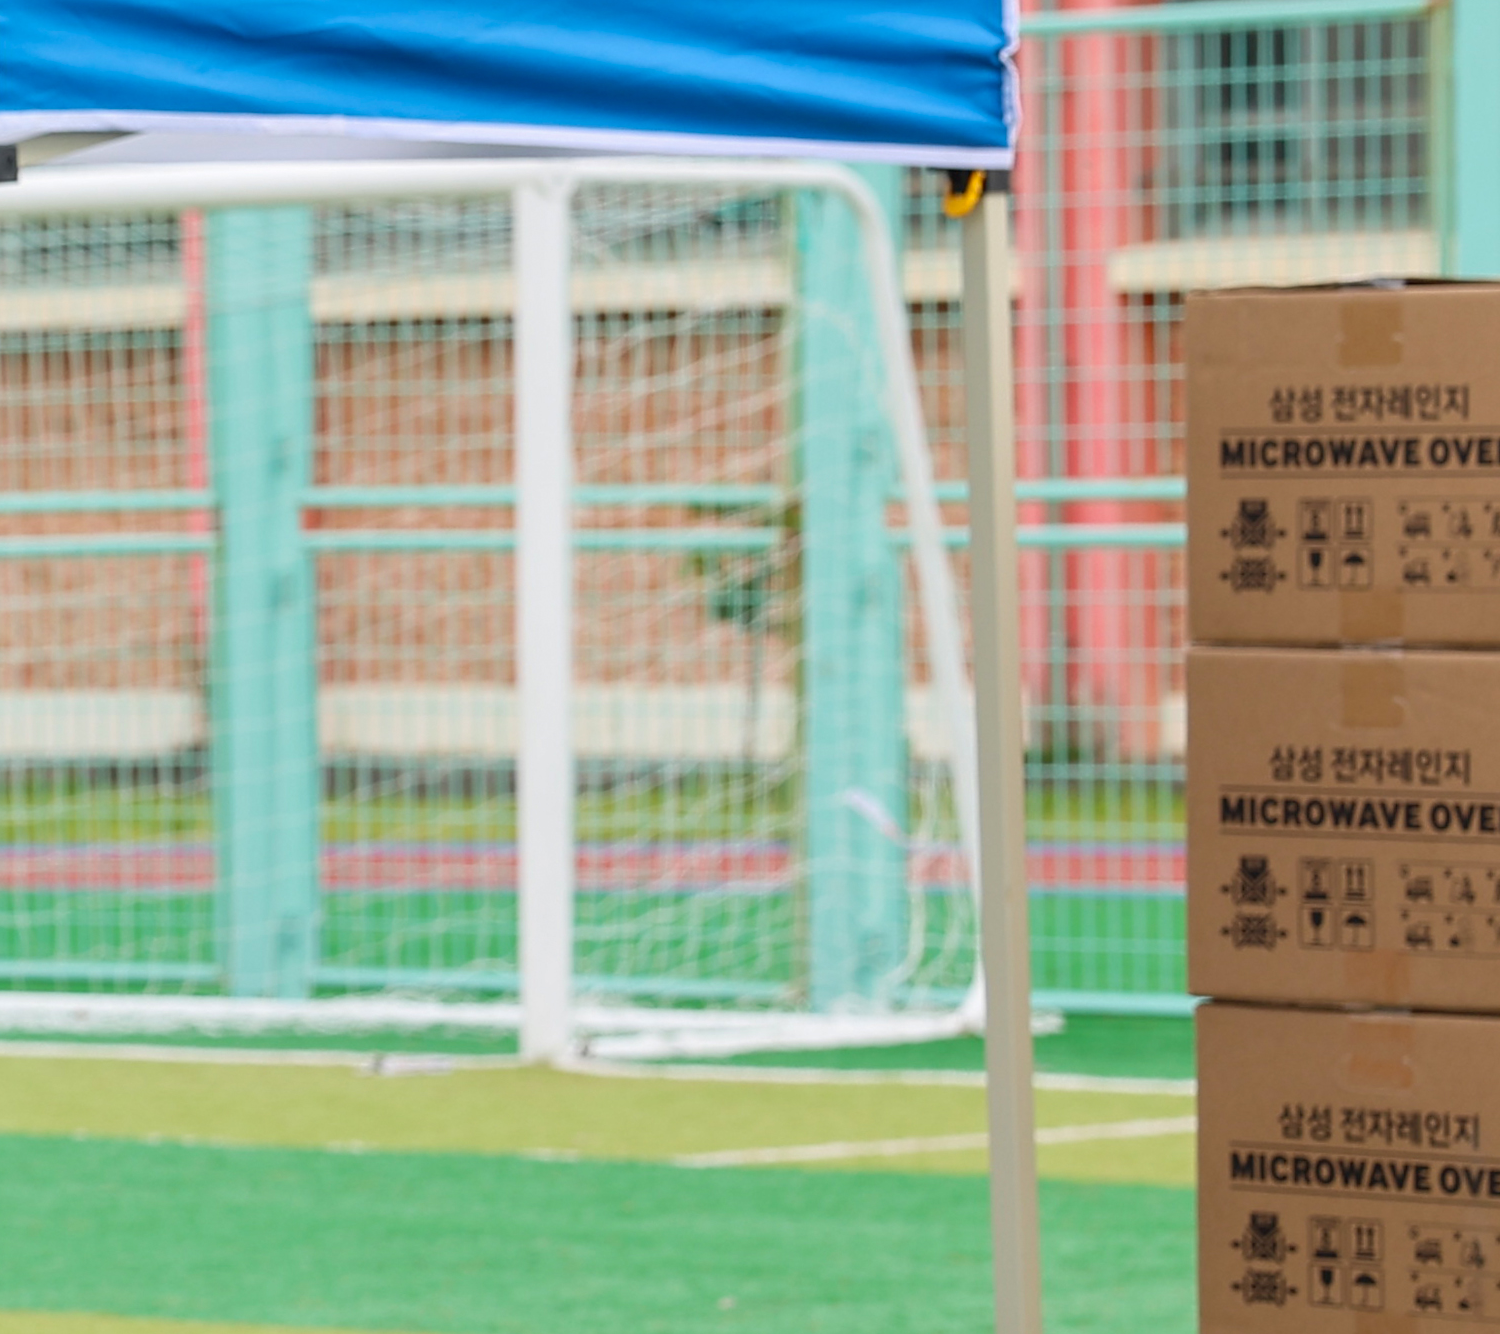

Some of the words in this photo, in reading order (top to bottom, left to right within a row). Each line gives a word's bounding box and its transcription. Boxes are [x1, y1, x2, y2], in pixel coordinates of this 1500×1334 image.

[1270, 385, 1323, 423] 삼성
[1331, 384, 1469, 421] 전자레인지
[1221, 437, 1421, 468] MICROWAVE
[1429, 437, 1500, 467] OVE
[1270, 745, 1323, 782] 삼성
[1331, 747, 1471, 786] 전자레인지
[1221, 796, 1422, 829] MICROWAVE
[1430, 803, 1500, 832] OVE
[1279, 1103, 1332, 1141] 삼성
[1341, 1107, 1480, 1150] 전자레인지
[1231, 1152, 1431, 1192] MICROWAVE
